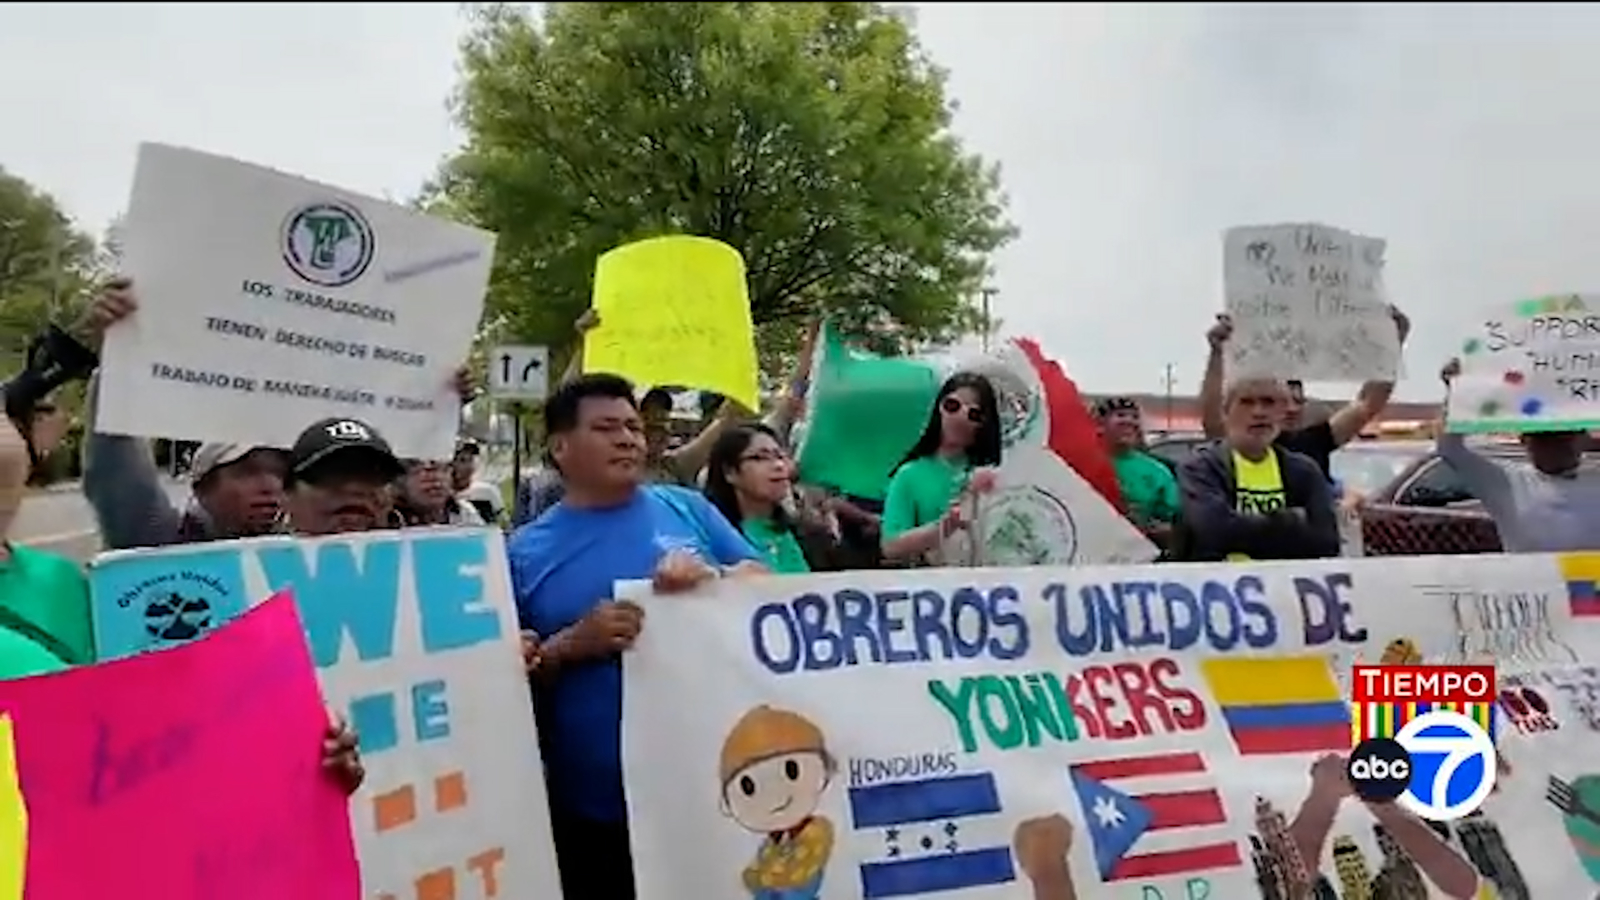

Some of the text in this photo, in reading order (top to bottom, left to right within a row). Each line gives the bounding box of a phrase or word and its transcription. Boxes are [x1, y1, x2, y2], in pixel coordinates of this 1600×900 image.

[243, 280, 273, 298] LOS
[205, 316, 267, 342] TIENEN
[275, 329, 345, 356] DERECHO
[348, 343, 368, 359] DE
[151, 363, 229, 388] TRABAJO
[232, 376, 255, 393] DE
[256, 535, 501, 667] WE
[752, 586, 1031, 674] OBREROS
[1042, 575, 1278, 656] UNIDOS
[1293, 573, 1367, 645] DE
[928, 658, 1206, 752] YONKERS
[849, 752, 957, 785] HONDURAS
